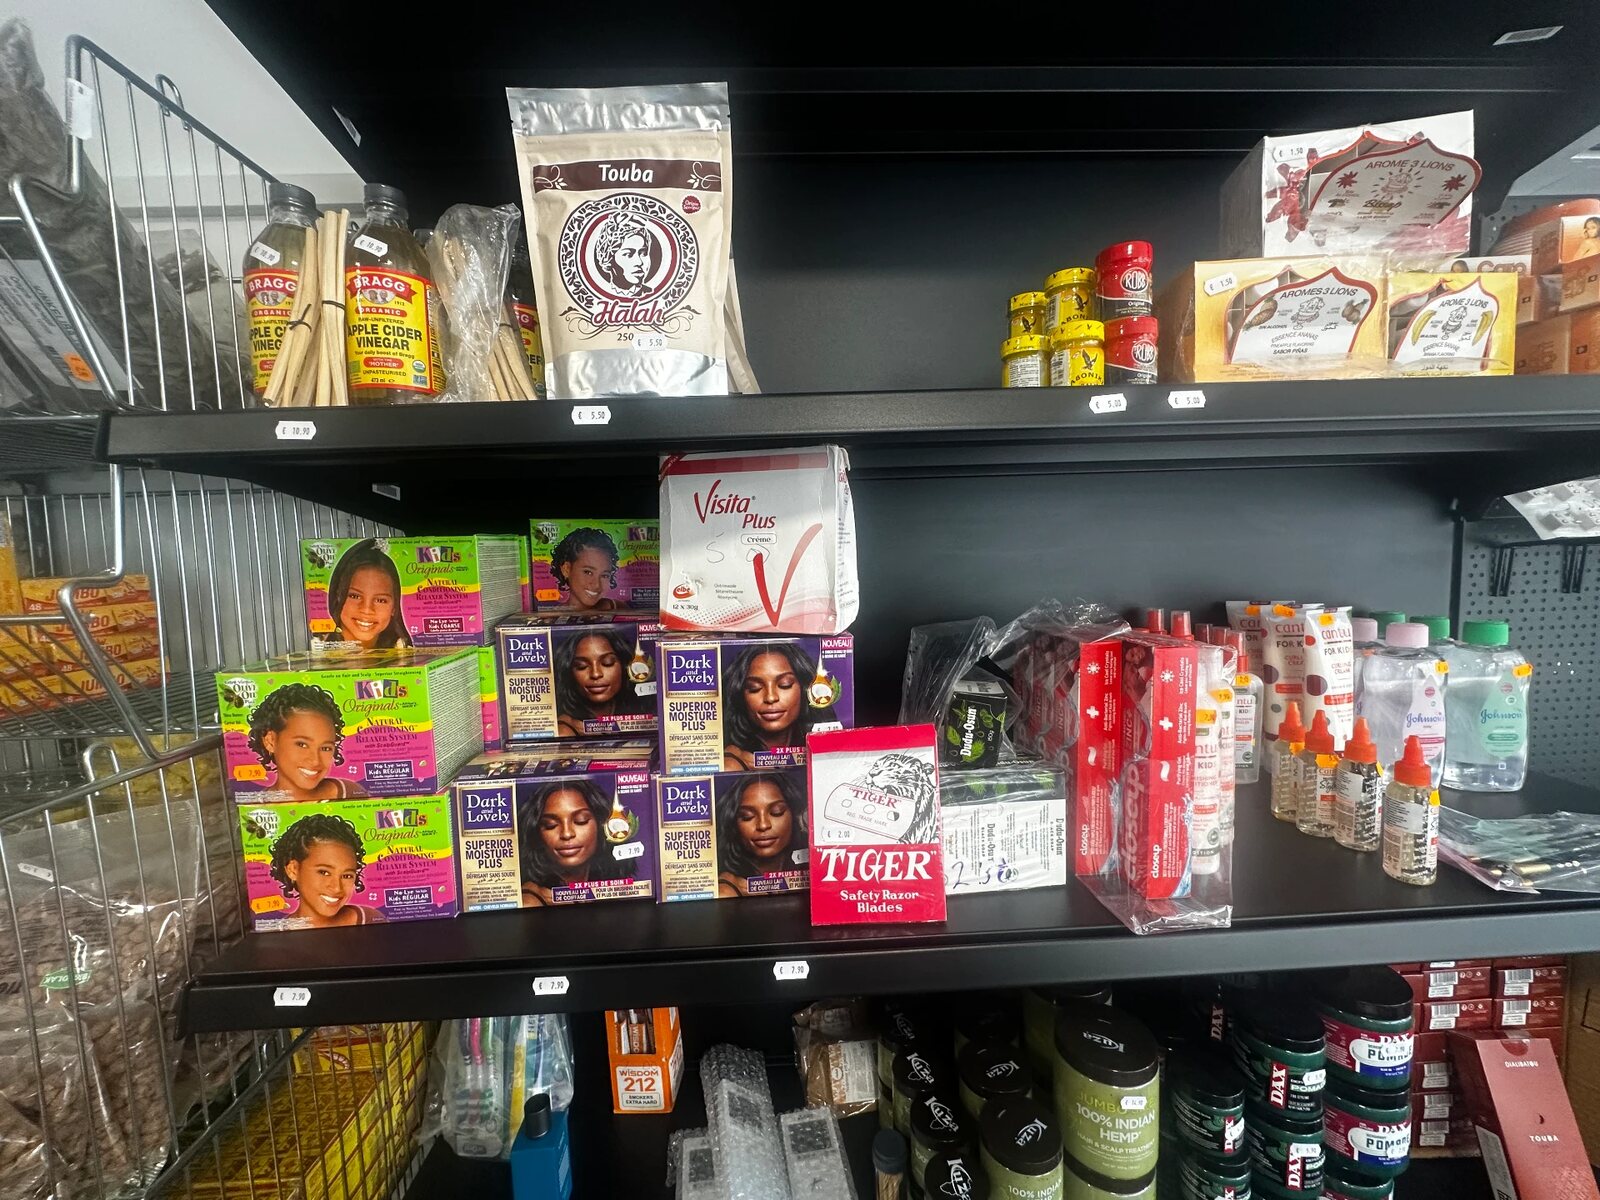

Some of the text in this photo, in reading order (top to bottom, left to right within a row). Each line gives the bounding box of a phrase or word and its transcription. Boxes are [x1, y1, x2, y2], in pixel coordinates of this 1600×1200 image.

[1365, 159, 1455, 172] AROME 3 LIONS
[598, 164, 653, 184] Touba
[249, 277, 297, 292] BRAGG
[354, 276, 406, 293] BRAGG
[1219, 277, 1233, 288] 1.50
[1280, 287, 1358, 300] AROMES LIONS
[1439, 298, 1465, 308] AROME
[359, 307, 402, 317] ORGANIC
[593, 299, 665, 327] Halah
[348, 325, 422, 342] APPLE CIDER
[617, 332, 634, 343] 250
[356, 337, 410, 351] VINEGAR
[1107, 399, 1122, 409] 5.00
[1186, 397, 1201, 406] 5.00
[578, 410, 606, 421] € 5.50
[282, 426, 311, 436] € 10.90
[693, 479, 751, 525] Visita
[742, 513, 776, 530] Plus
[416, 546, 461, 563] Kids
[405, 561, 454, 578] Originals
[46, 588, 100, 601] JBO
[29, 603, 42, 611] 48
[1321, 628, 1352, 641] cantu
[509, 637, 544, 651] Dark
[510, 651, 547, 664] Lovely
[1324, 646, 1352, 656] FOR KID
[671, 654, 711, 670] Dark
[509, 676, 550, 687] SUPERIOR
[671, 671, 714, 686] Lovely
[355, 679, 408, 700] Kids
[509, 685, 551, 696] MOISTURE
[520, 693, 542, 703] PLUS
[342, 698, 400, 718] Originals
[669, 701, 717, 712] SUPERIOR
[367, 717, 404, 726] NATURAL
[669, 710, 718, 721] MOISTURE
[357, 725, 415, 734] CONDITIONING
[681, 721, 706, 731] PLUS
[960, 706, 978, 757] Dudu-Osun
[388, 733, 418, 742] SYSTEM
[669, 734, 692, 742] DÉFRISANT
[666, 785, 706, 801] Dark
[466, 793, 507, 809] Dark
[666, 801, 708, 816] Lovely
[376, 808, 428, 829] Kids
[466, 809, 510, 825] Lovely
[1121, 762, 1145, 881] closeup
[363, 827, 420, 846] Originals
[664, 830, 711, 842] SUPERIOR
[838, 830, 850, 839] 2.00
[1080, 824, 1090, 856] closeup
[387, 845, 424, 855] NATURAL
[465, 838, 513, 850] SUPERIOR
[664, 839, 712, 851] MOISTURE
[377, 852, 434, 862] CONDITIONING
[465, 848, 514, 860] MOISTURE
[676, 850, 701, 860] PLUS
[408, 861, 437, 869] SYSTEM
[478, 858, 503, 869] PLUS
[1151, 844, 1162, 879] closeup
[402, 893, 429, 901] REGULAR
[840, 889, 919, 903] Safety Razor
[857, 902, 903, 913] Blades
[791, 965, 805, 975] 7.90
[550, 981, 565, 990] 7.90
[292, 992, 306, 1001] 7.90
[1210, 1004, 1225, 1040] DAX
[906, 1051, 936, 1085] Kuza
[985, 1060, 1021, 1080] Kuza
[624, 1077, 656, 1092] 212
[1270, 1066, 1287, 1106] DAX
[923, 1095, 961, 1134] Kuza
[1076, 1102, 1156, 1130] 100% INDIAN
[1014, 1117, 1049, 1148] Kuza
[1099, 1127, 1140, 1144] HEMP
[1529, 1135, 1560, 1143] TOUBA
[1101, 1144, 1124, 1154] SCALP
[1008, 1184, 1035, 1198] 100%
